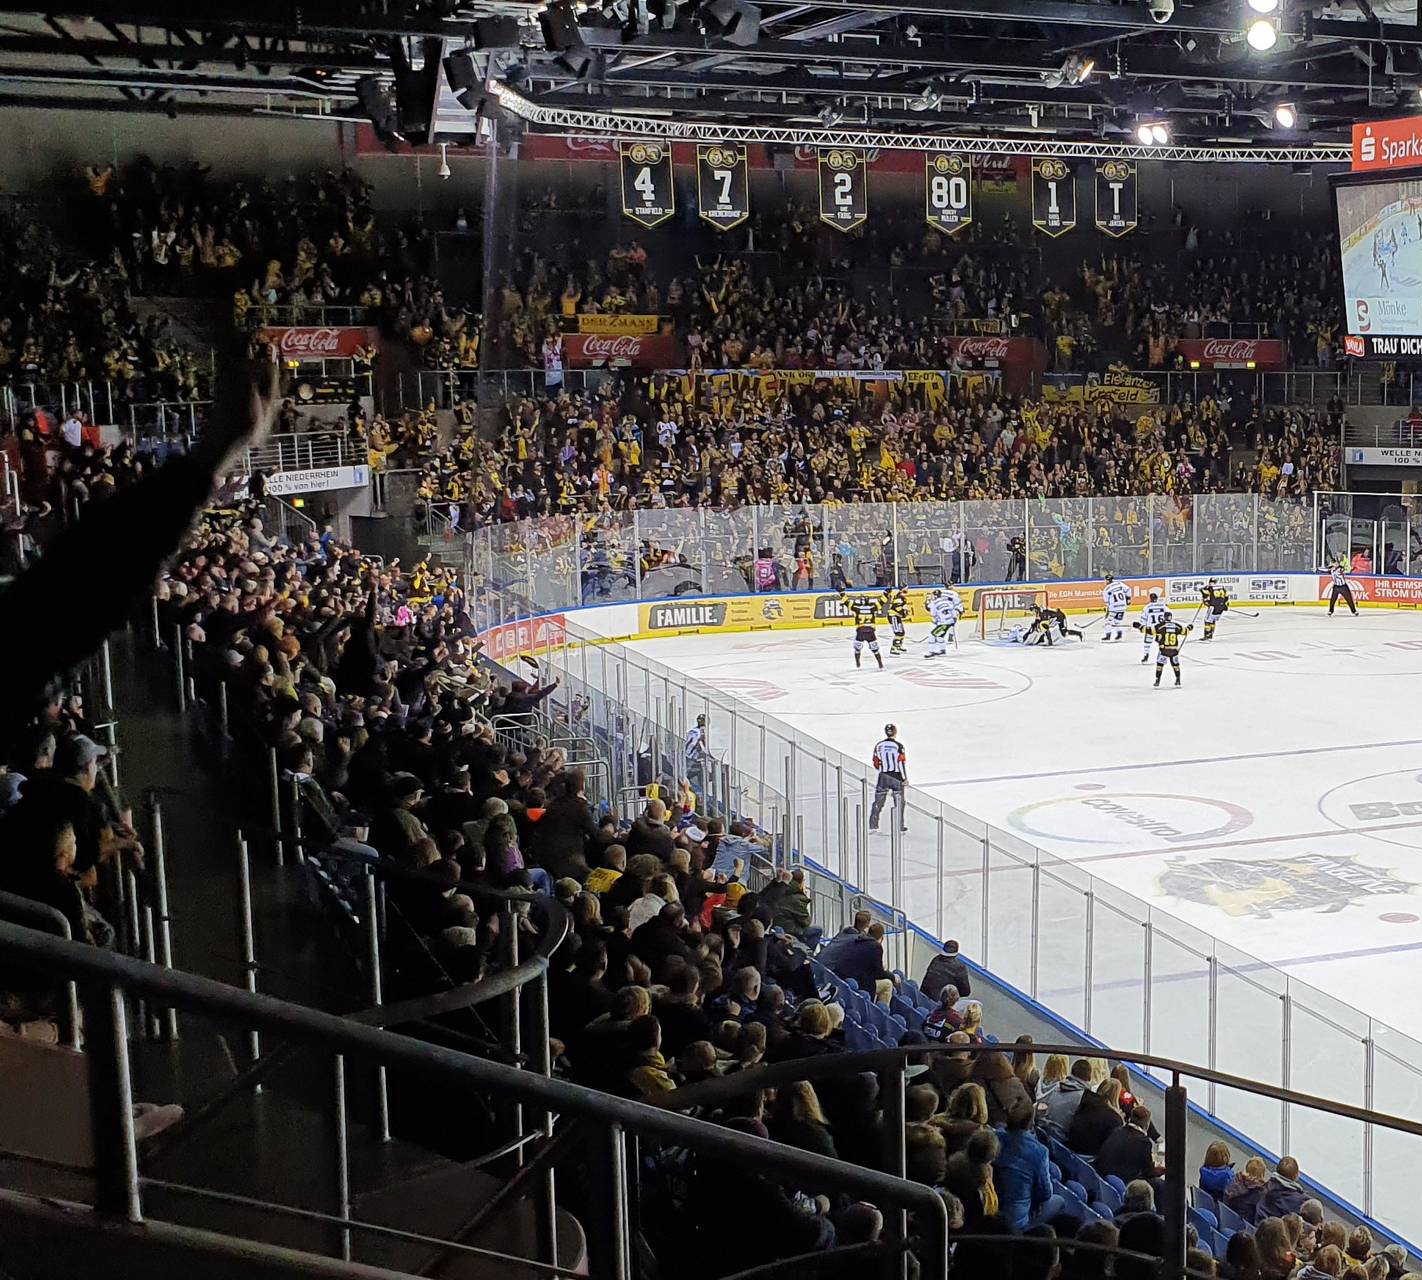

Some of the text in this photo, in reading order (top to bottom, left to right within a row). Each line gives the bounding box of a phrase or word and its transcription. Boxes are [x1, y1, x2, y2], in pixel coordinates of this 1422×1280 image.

[633, 166, 655, 201] 4
[713, 170, 732, 204] 7
[834, 172, 853, 206] 2
[931, 175, 967, 209] 80
[1047, 181, 1060, 214] 1
[1109, 182, 1124, 214] T
[1377, 300, 1407, 316] Mönke
[1380, 449, 1412, 458] WELLE
[1393, 456, 1410, 464] 100
[285, 470, 339, 482] NIEDERRHEIN
[294, 482, 309, 490] von
[310, 479, 330, 489] hier!
[1171, 581, 1204, 593] SPC
[1251, 579, 1287, 591] SPC
[1375, 580, 1390, 590] IHR
[1112, 592, 1124, 603] 10
[1375, 588, 1404, 598] STROM
[656, 606, 718, 627] FAMILIE.
[1151, 614, 1164, 624] 16
[1164, 632, 1177, 646] 19
[1080, 798, 1183, 837] covestro
